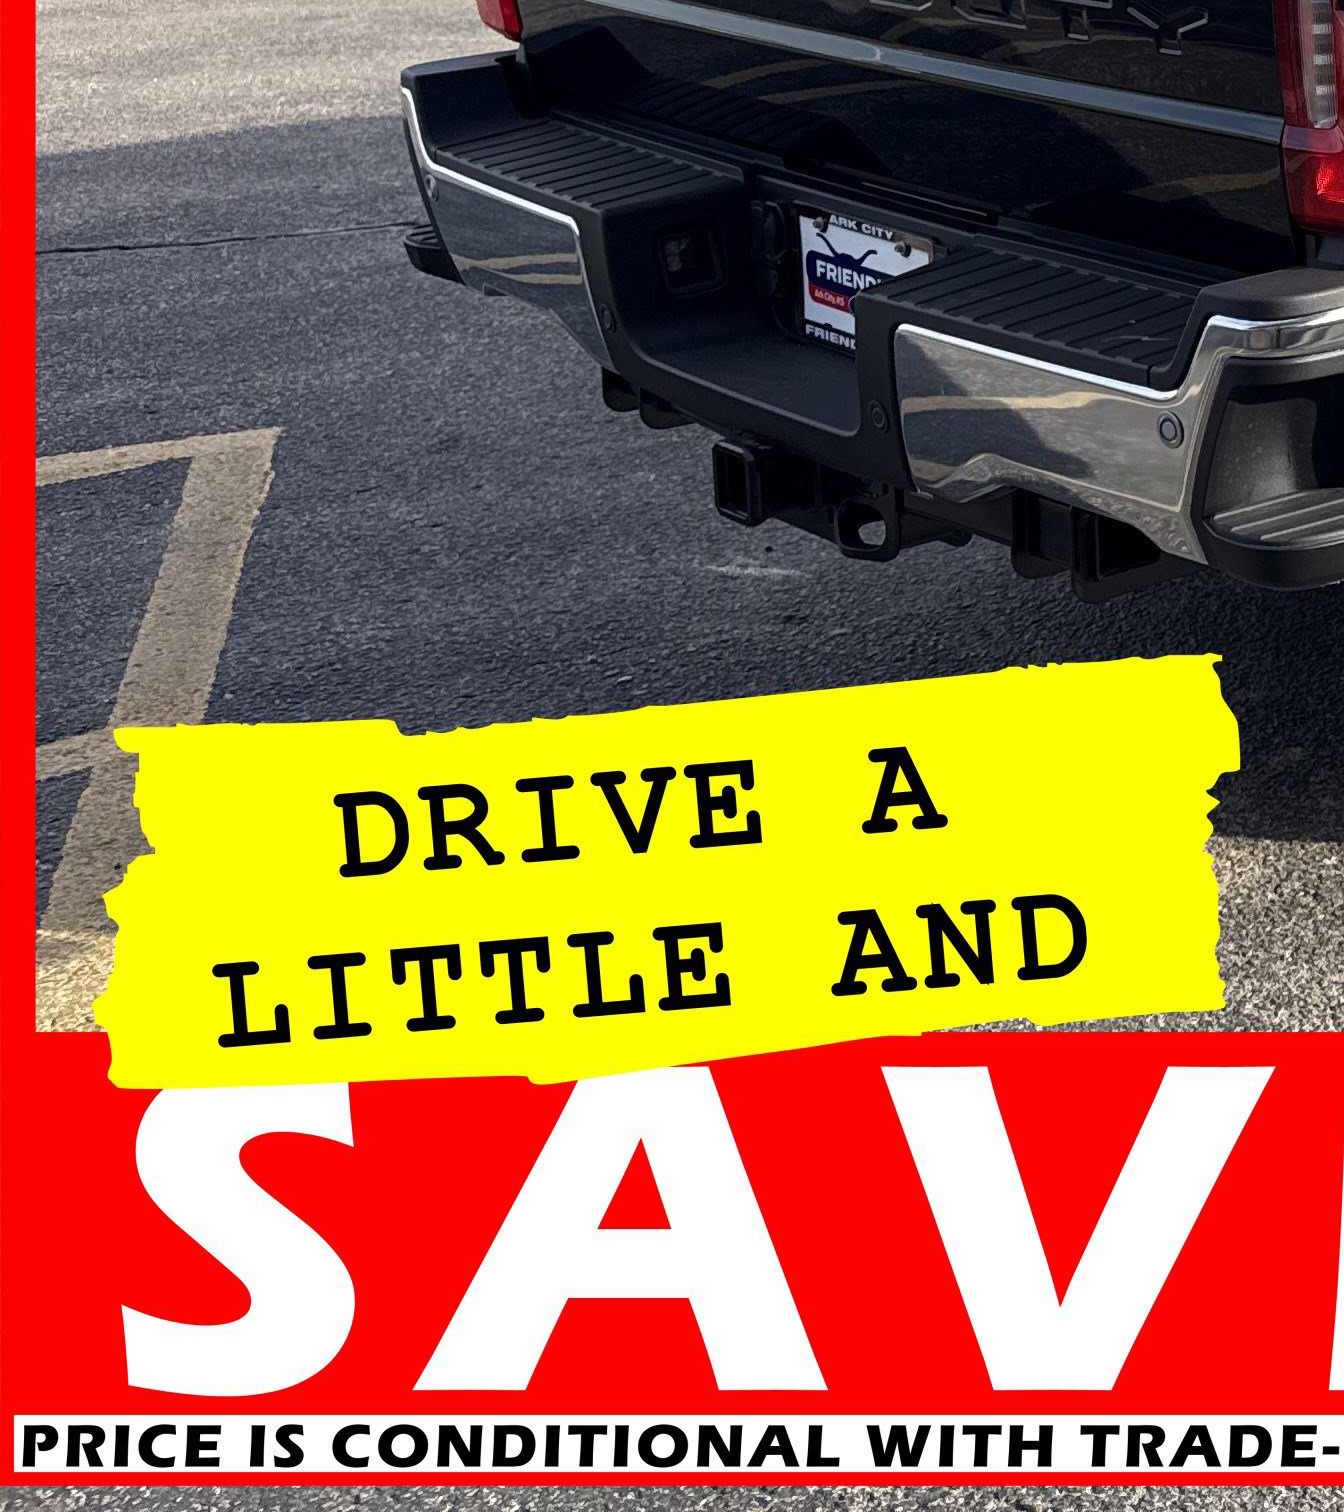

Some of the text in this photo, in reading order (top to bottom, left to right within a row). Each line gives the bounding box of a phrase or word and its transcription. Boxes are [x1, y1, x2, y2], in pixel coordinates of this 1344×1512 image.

[829, 214, 894, 240] ARK CITY
[816, 259, 881, 290] FRIEND
